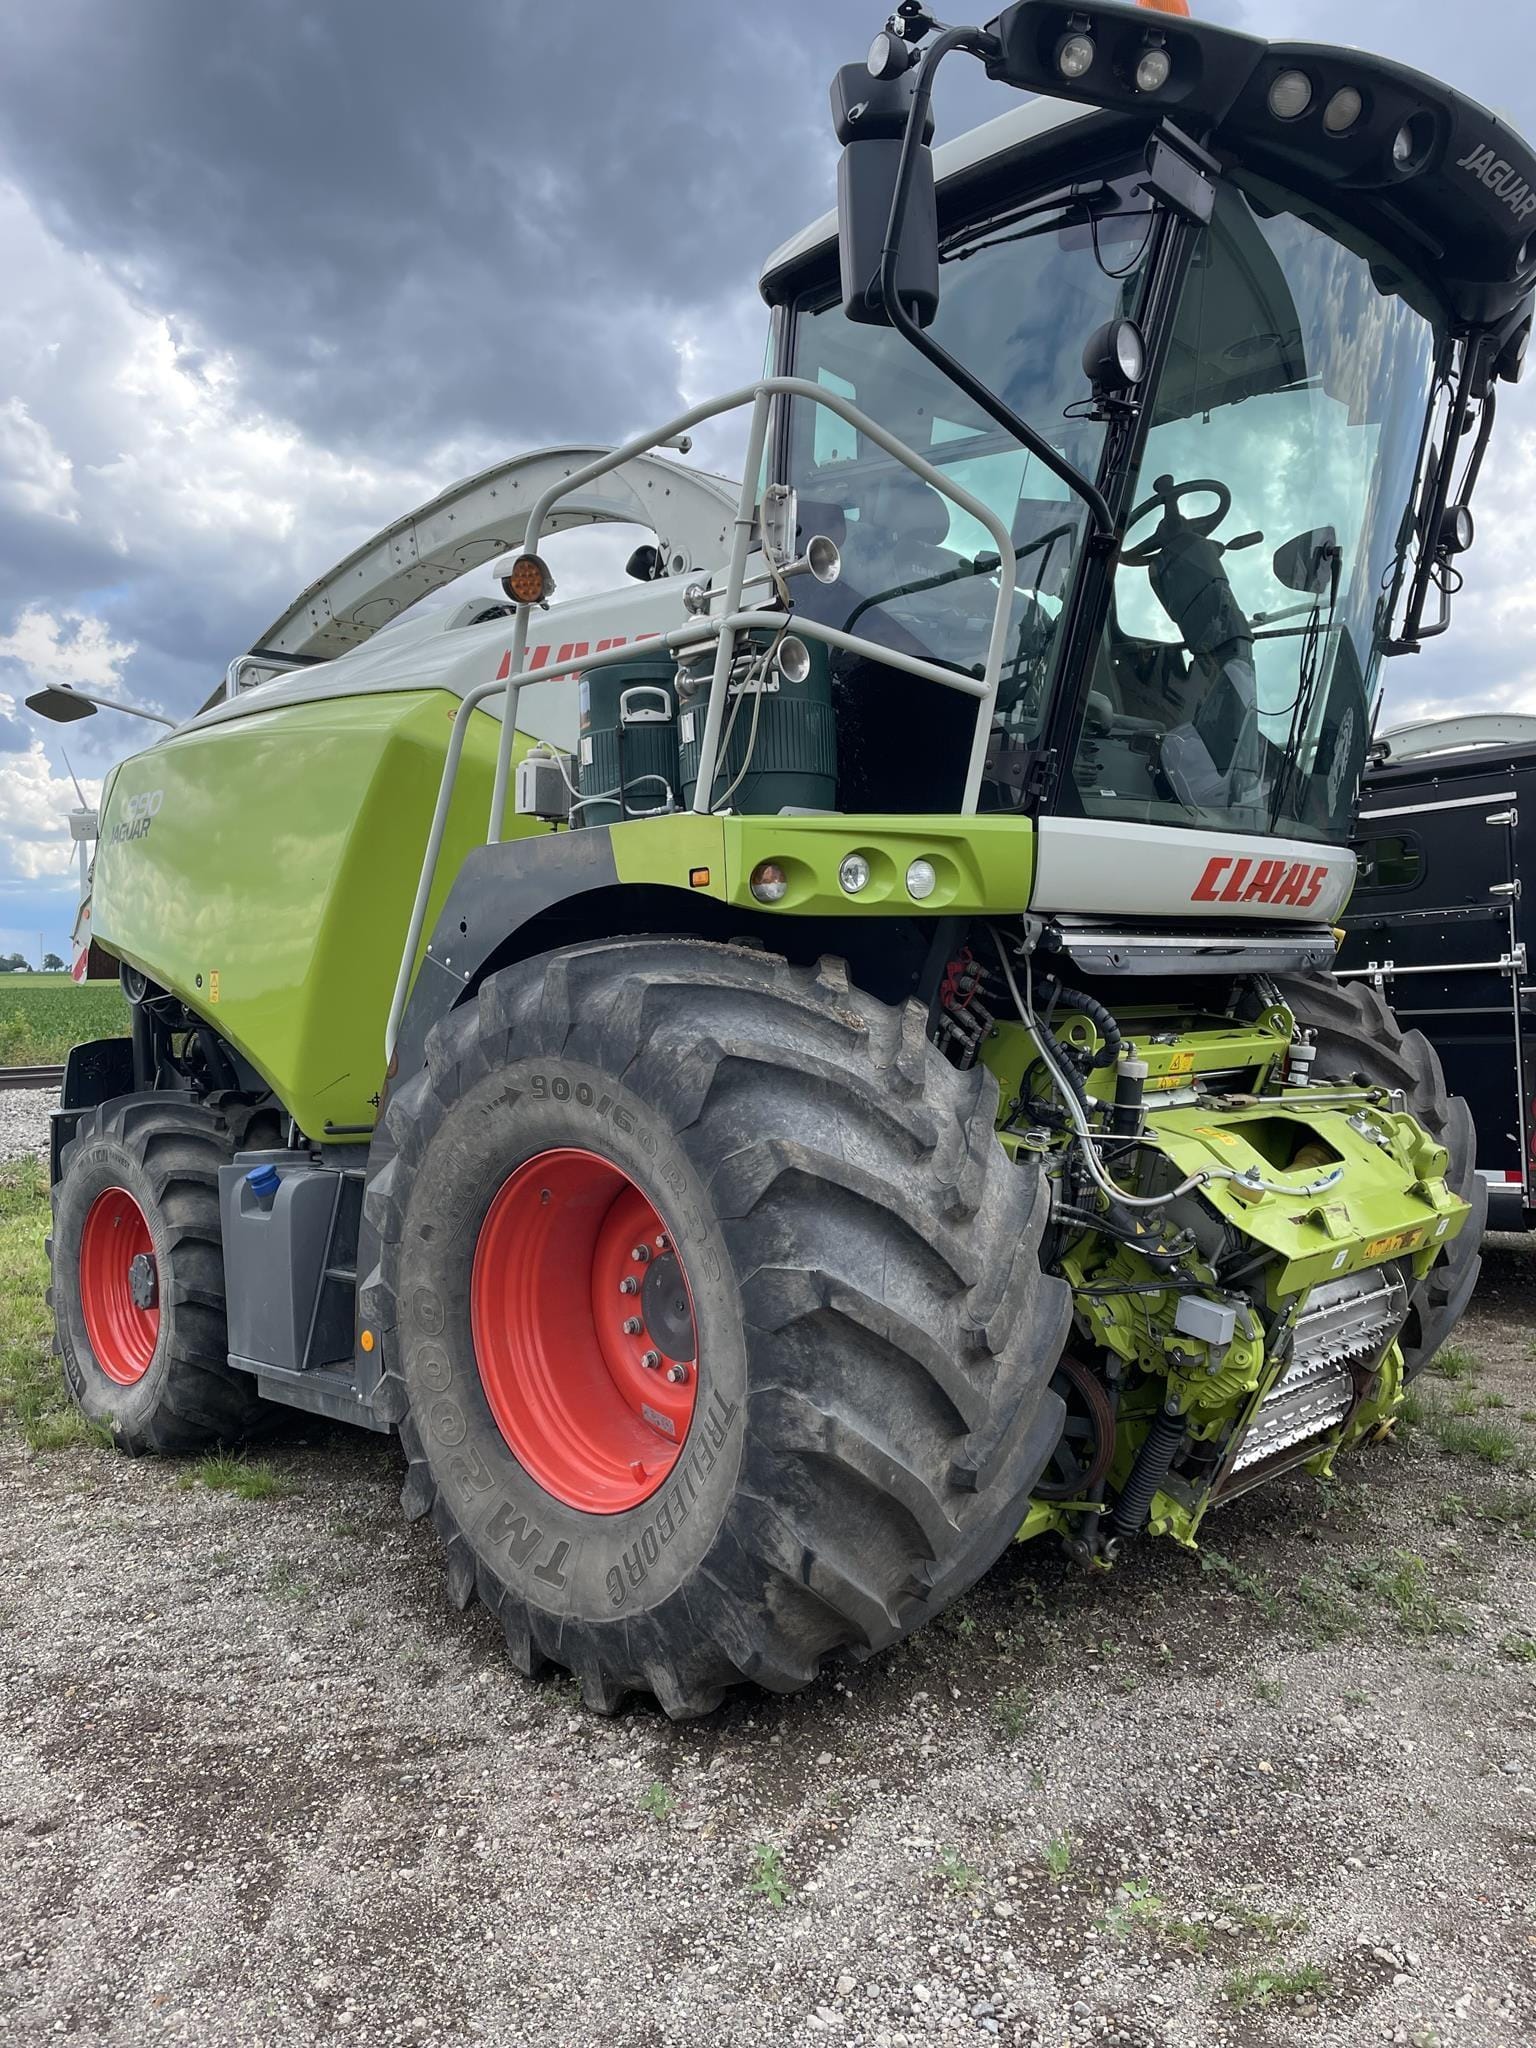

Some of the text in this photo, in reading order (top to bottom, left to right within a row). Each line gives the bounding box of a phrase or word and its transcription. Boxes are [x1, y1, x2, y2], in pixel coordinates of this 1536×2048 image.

[1455, 143, 1536, 222] JAGUAR
[109, 817, 152, 846] JAGUAR
[1190, 857, 1329, 907] CLAAS
[604, 1388, 740, 1610] TRELLEBORG
